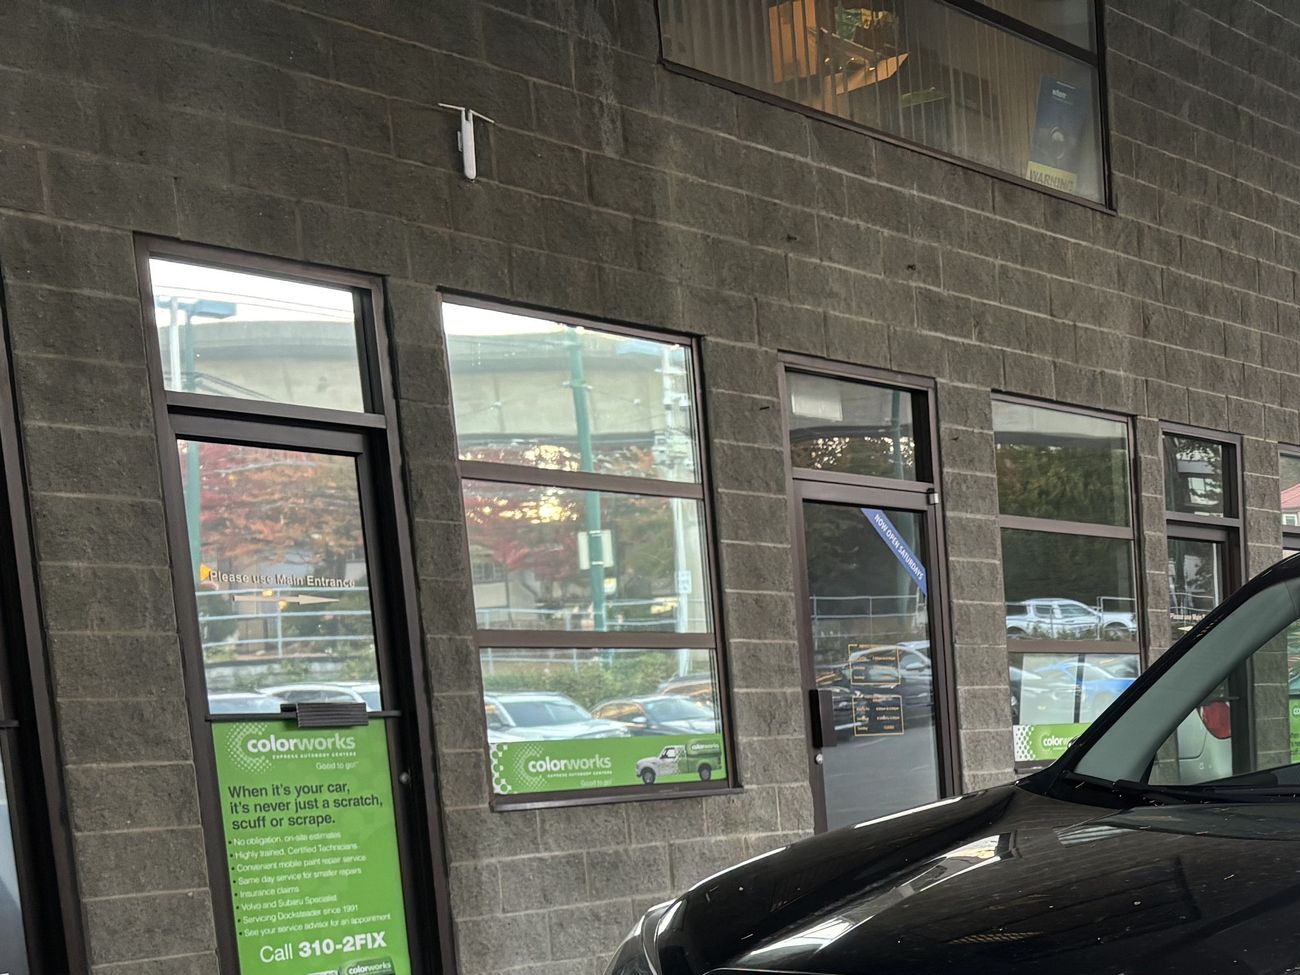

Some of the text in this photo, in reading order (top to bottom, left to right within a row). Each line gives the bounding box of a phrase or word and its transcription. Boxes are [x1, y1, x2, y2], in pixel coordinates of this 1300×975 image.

[874, 514, 924, 580] NOW OPEN SATURDAYS
[209, 570, 355, 588] Please use Main Entrance
[247, 733, 356, 752] colorworks
[528, 754, 612, 772] colorworks
[228, 782, 350, 798] When it's your car,
[230, 794, 383, 814] it's never just a scratch,
[231, 814, 336, 830] scuff or scrape.
[233, 838, 245, 846] No
[235, 850, 258, 860] Highly
[287, 846, 317, 855] Certified
[236, 862, 278, 873] Convenient
[278, 860, 302, 869] mobile
[303, 858, 320, 867] paint
[238, 876, 260, 886] Same
[261, 875, 275, 884] day
[276, 873, 301, 881] service
[302, 871, 312, 879] for
[313, 869, 338, 878] smaller
[239, 886, 300, 898] Insurance claims
[241, 901, 262, 911] Volvo
[262, 900, 277, 909] and
[278, 898, 304, 908] Subaru
[243, 912, 277, 924] Servicing
[322, 906, 341, 915] since
[342, 904, 358, 913] 1991
[243, 928, 259, 937] See
[260, 926, 277, 936] your
[277, 924, 303, 933] service
[330, 918, 340, 926] for
[259, 931, 387, 963] Call 310-2FIX
[348, 962, 391, 975] colorworks
